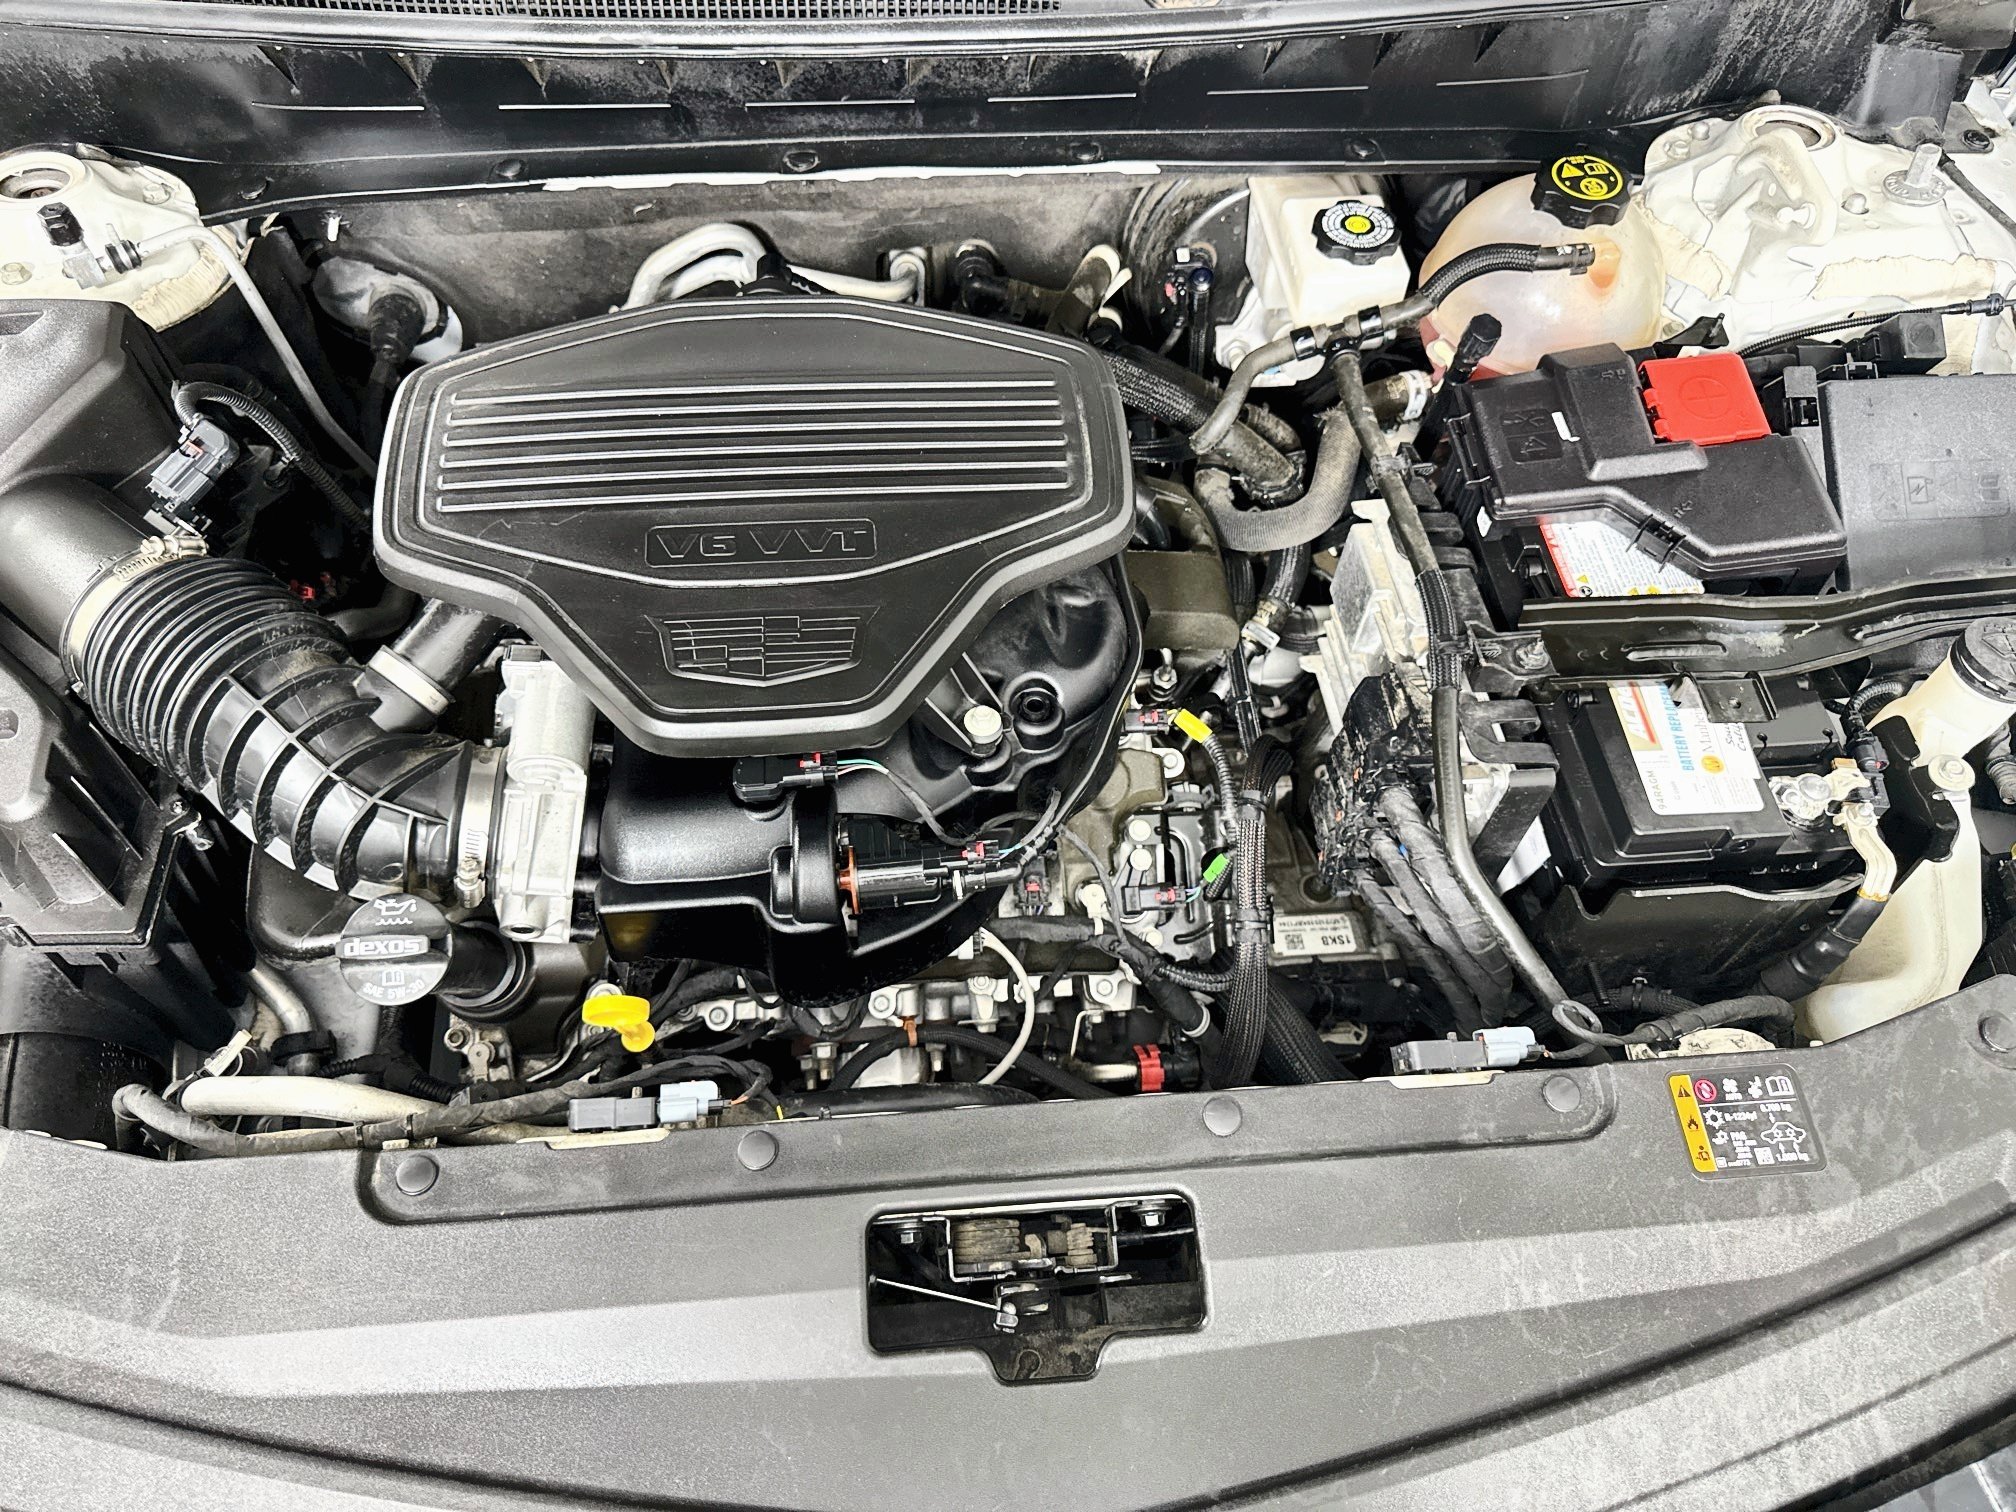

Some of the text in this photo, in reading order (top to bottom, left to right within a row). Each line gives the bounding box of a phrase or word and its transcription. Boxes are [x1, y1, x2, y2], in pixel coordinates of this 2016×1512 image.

[656, 528, 867, 558] V6 VVT
[1673, 735, 1695, 771] BATTERY
[344, 938, 422, 956] dexos
[362, 982, 384, 998] SAE
